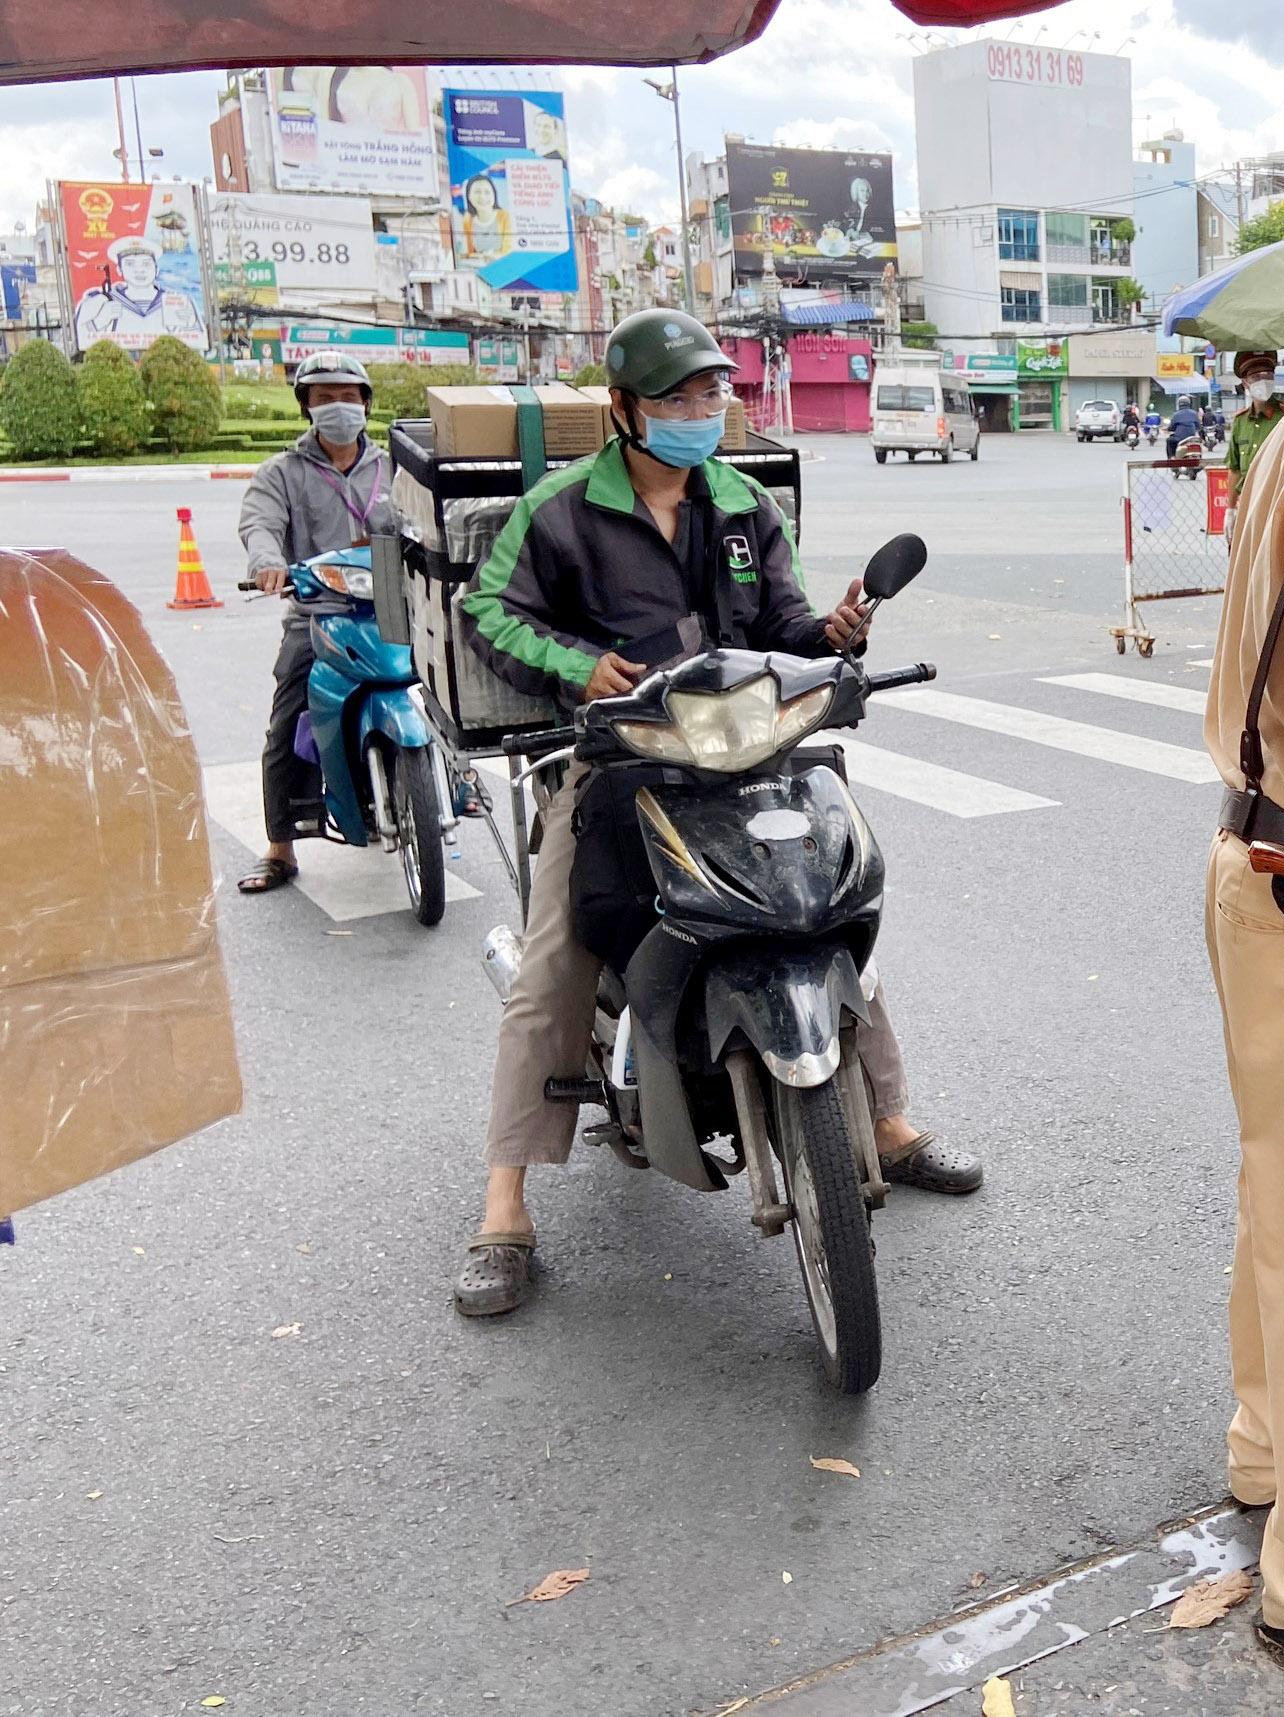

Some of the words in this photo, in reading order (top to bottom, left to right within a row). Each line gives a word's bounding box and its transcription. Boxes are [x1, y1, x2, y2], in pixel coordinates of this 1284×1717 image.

[988, 45, 1022, 80] 0913
[1026, 49, 1041, 81] 31
[1047, 52, 1062, 84] 31
[1067, 54, 1083, 86] 69
[739, 782, 787, 796] HONDA
[662, 922, 698, 945] HONDA
